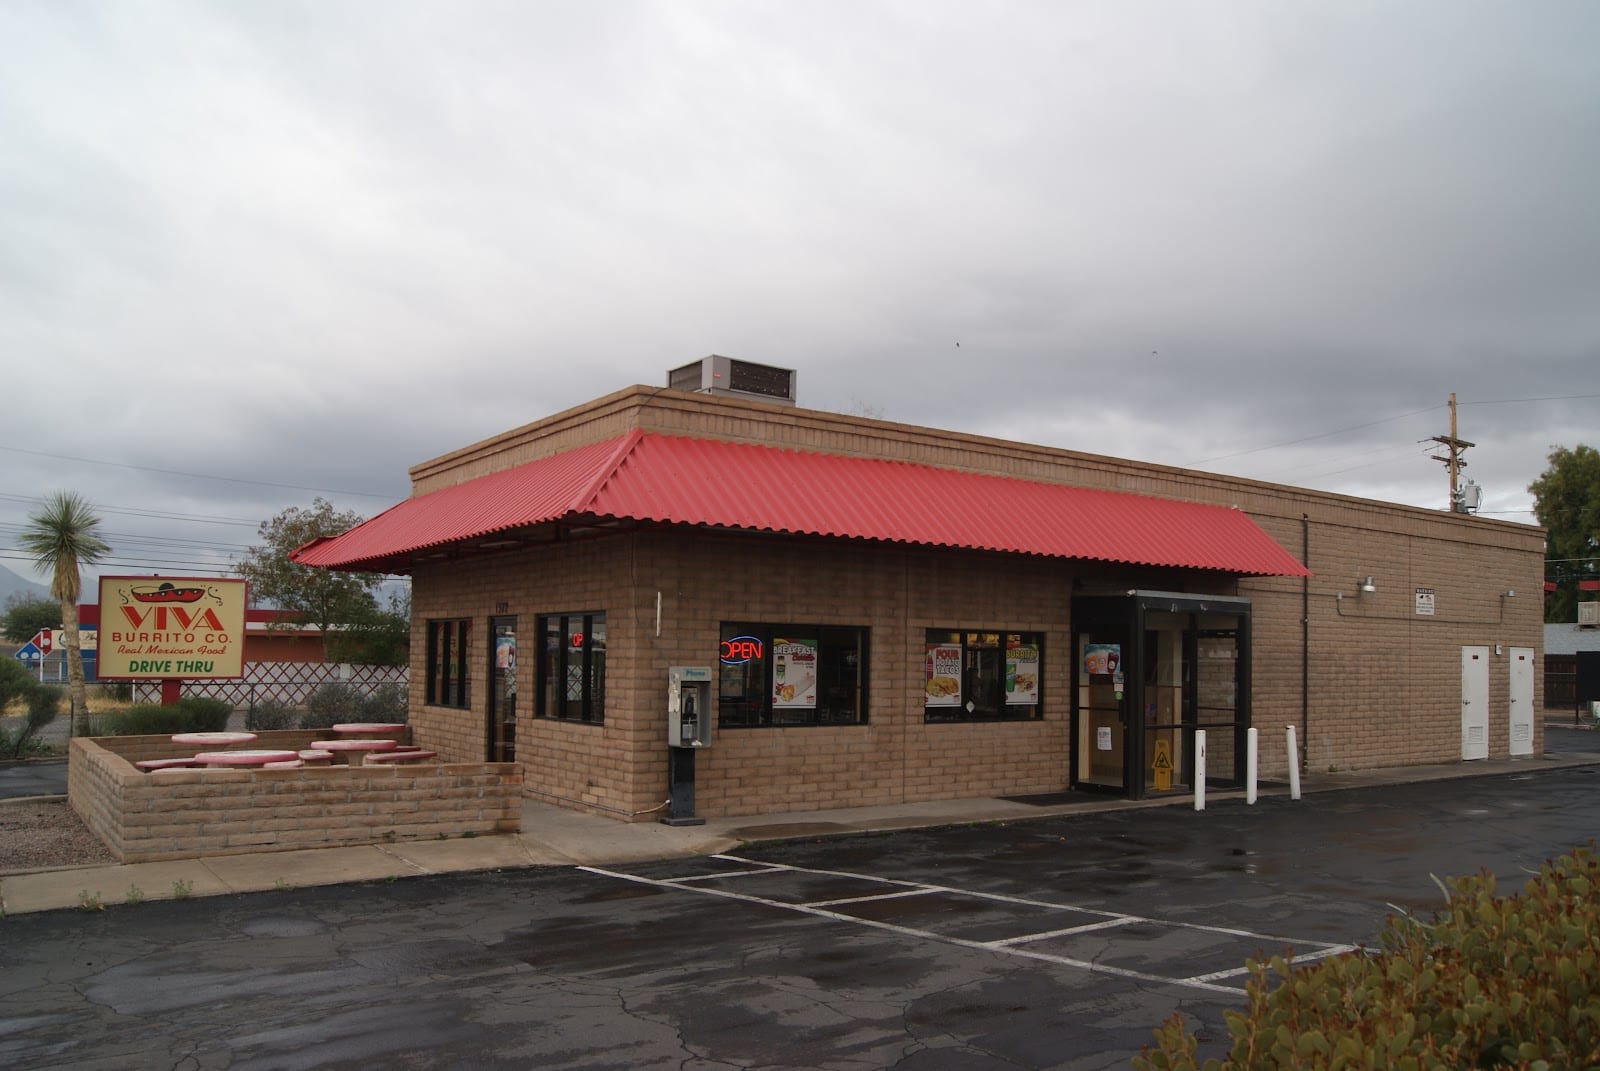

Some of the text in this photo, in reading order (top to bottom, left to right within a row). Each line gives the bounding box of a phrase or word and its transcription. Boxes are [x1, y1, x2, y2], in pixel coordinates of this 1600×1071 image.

[120, 606, 224, 631] VIVA
[112, 632, 232, 643] BURRITO CO.
[117, 645, 227, 655] Real Mexican Food
[720, 641, 762, 659] OPEN
[773, 646, 815, 655] BREAKFAST
[129, 660, 214, 673] DRIVE THRU
